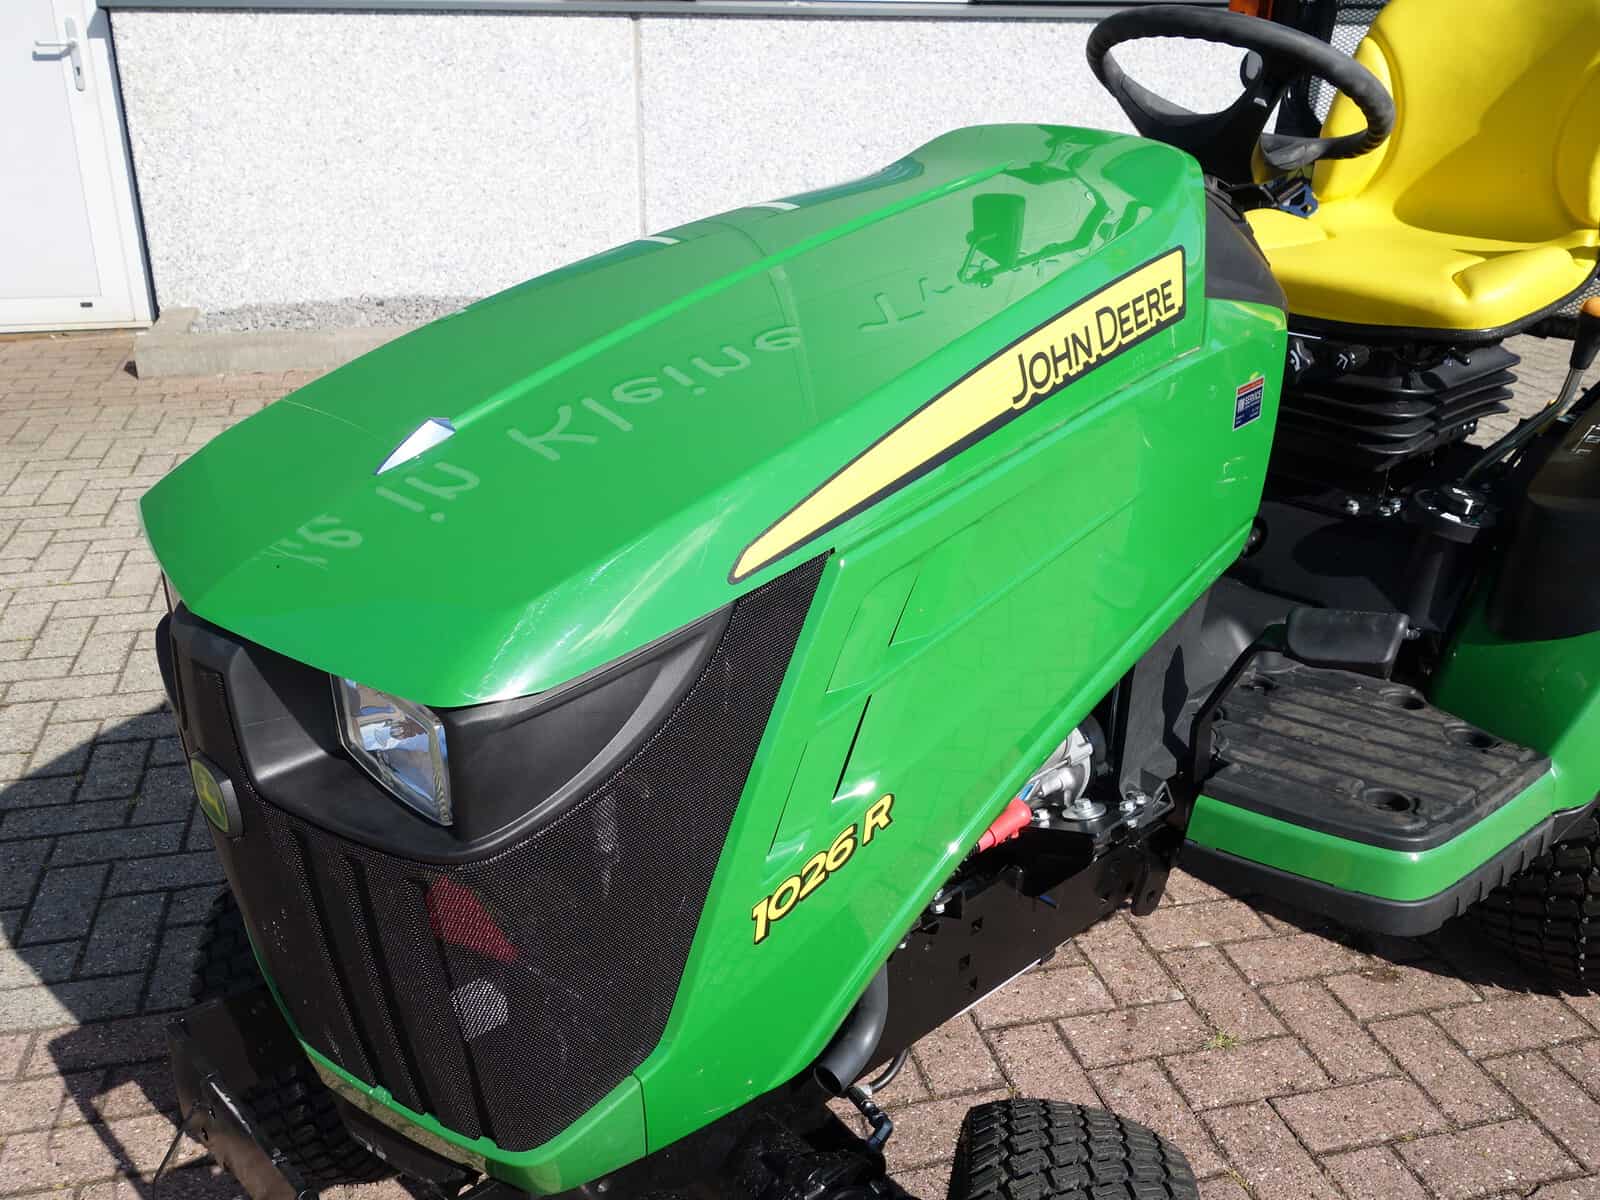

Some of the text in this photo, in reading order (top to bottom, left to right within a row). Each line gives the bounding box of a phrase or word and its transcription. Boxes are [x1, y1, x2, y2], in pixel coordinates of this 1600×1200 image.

[1013, 280, 1175, 404] JOHN DEERE
[752, 793, 894, 944] 1026 R
